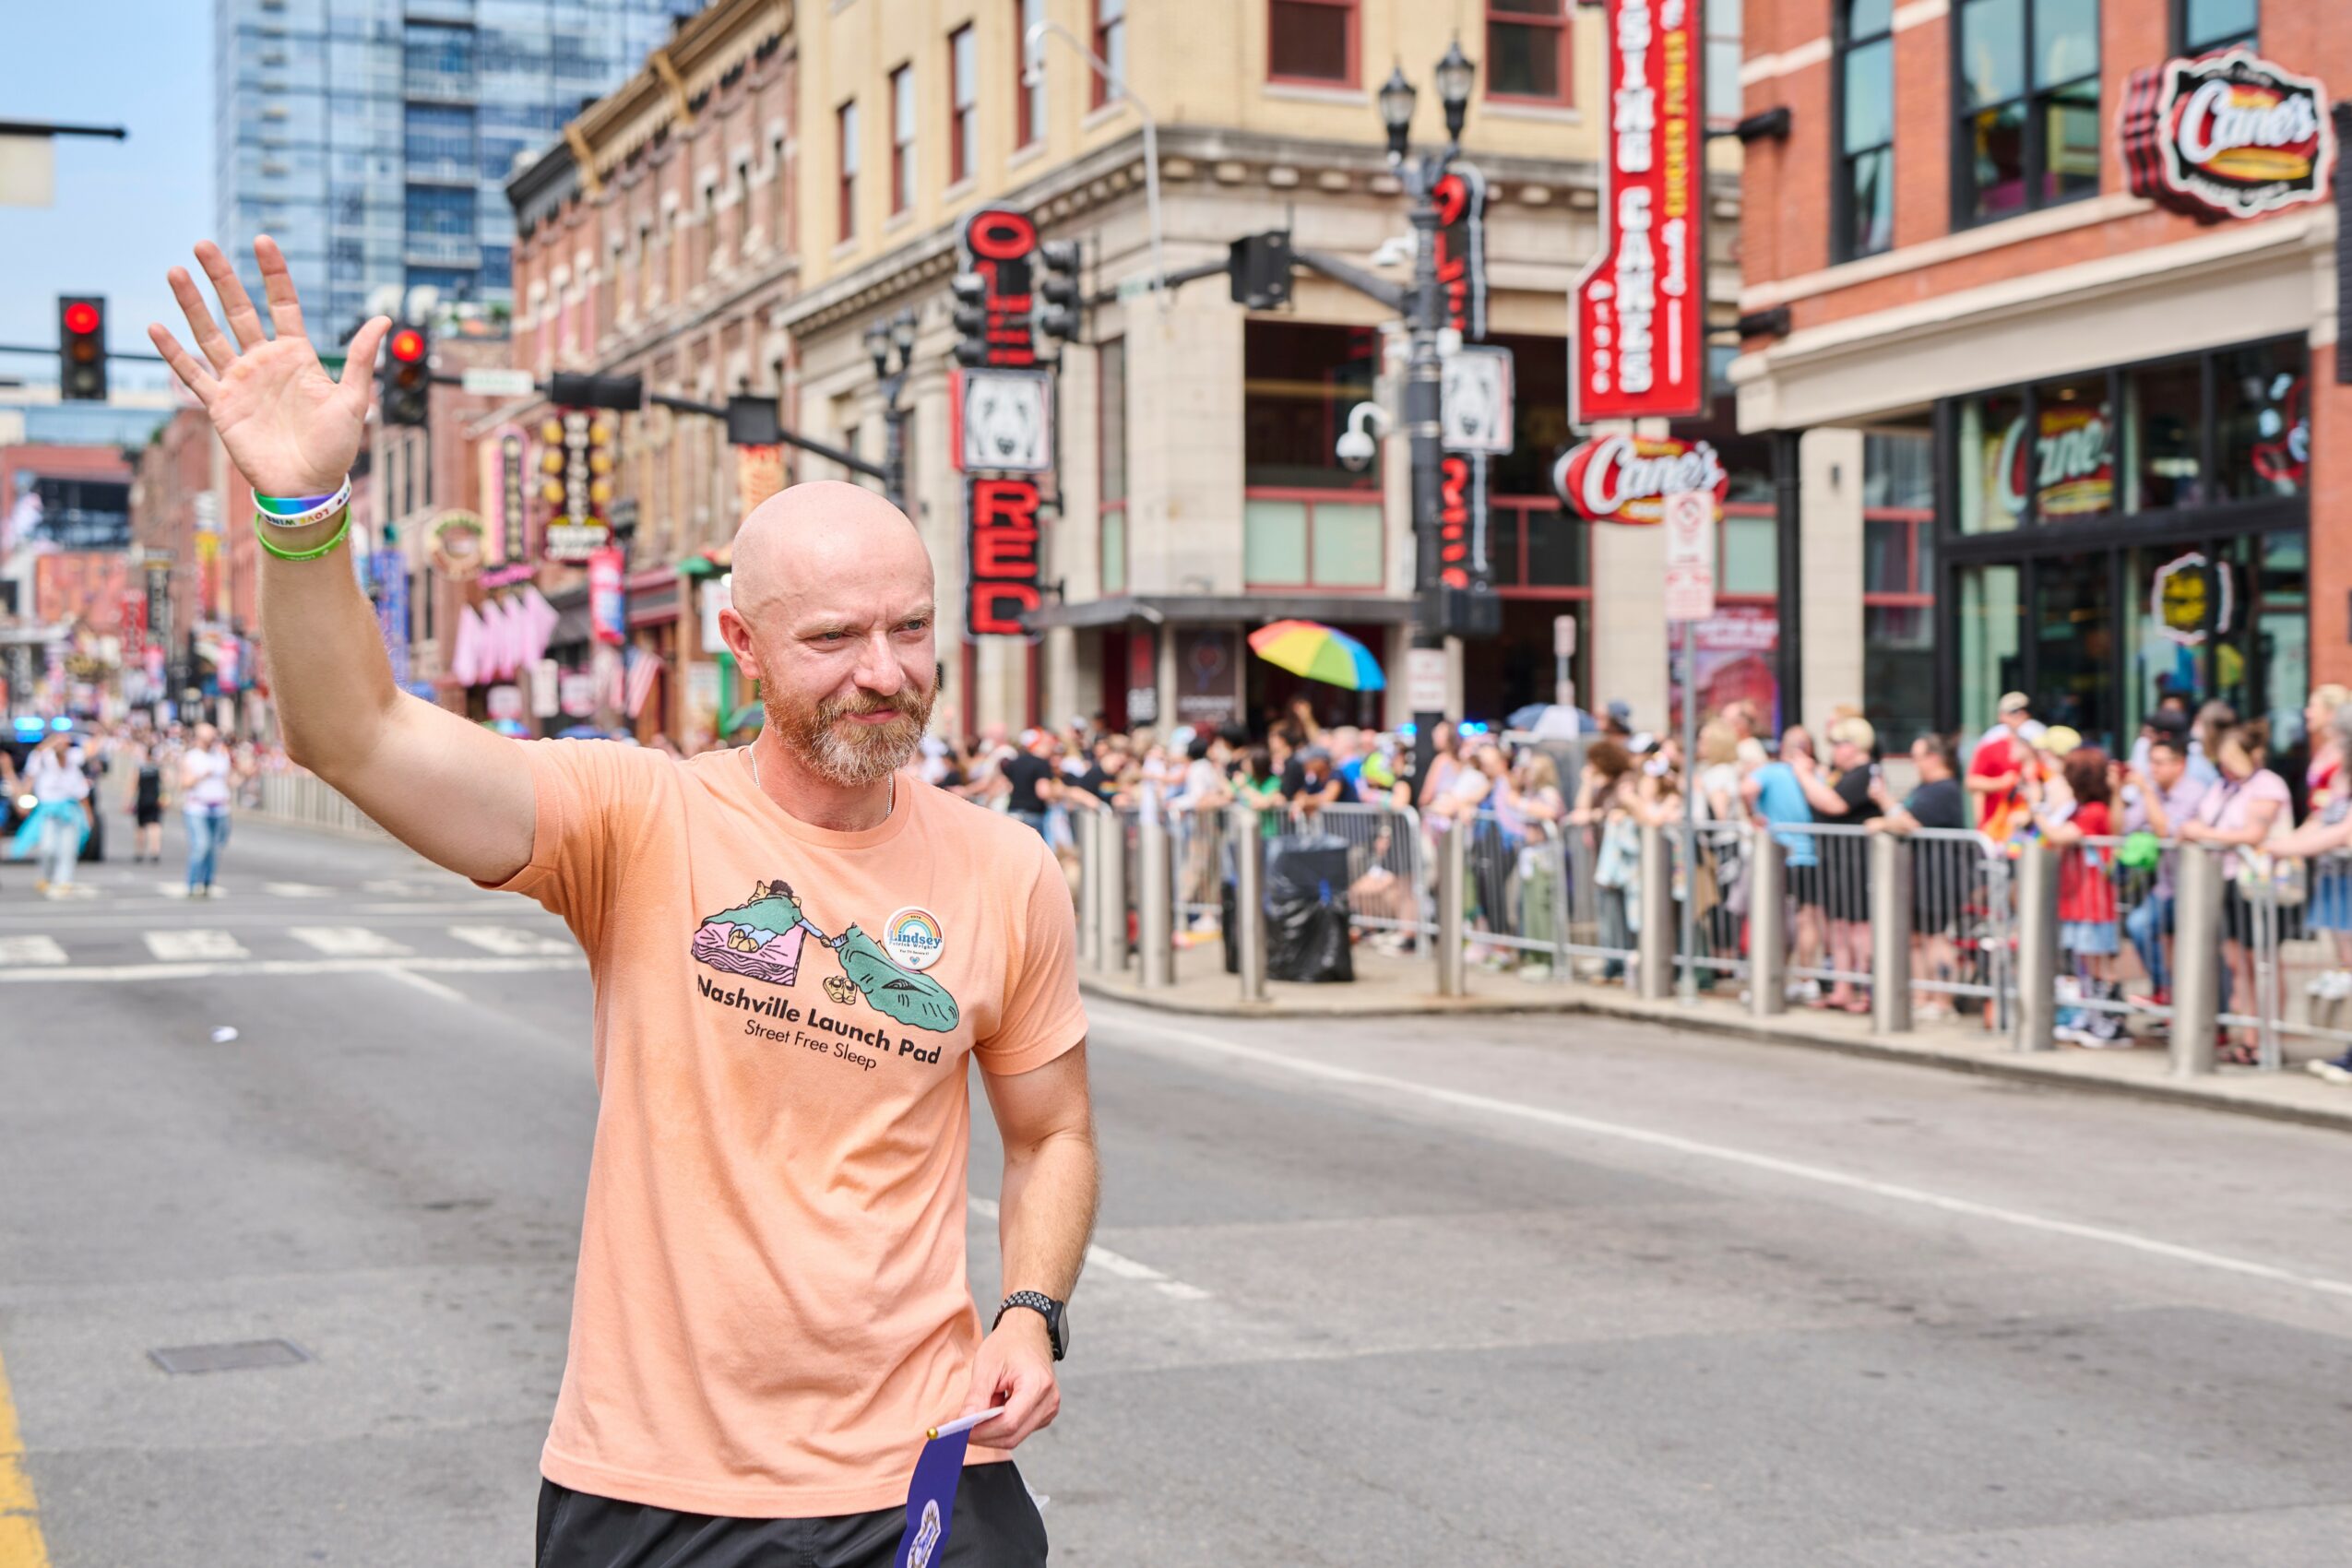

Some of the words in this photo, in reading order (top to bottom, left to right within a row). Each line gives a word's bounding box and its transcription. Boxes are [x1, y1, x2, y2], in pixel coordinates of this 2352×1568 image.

[2179, 79, 2317, 163] Cane's
[1616, 186, 1656, 393] CANES
[1583, 436, 1727, 515] Cane's
[300, 508, 330, 525] LOVE
[972, 479, 1041, 635] RED
[889, 929, 943, 949] Lindsey
[697, 974, 801, 1023] Nashville
[807, 1008, 891, 1051] Launch
[898, 1039, 942, 1064] Pad
[744, 1019, 790, 1043] Street
[794, 1031, 828, 1052] Free
[833, 1042, 877, 1071] Sleep
